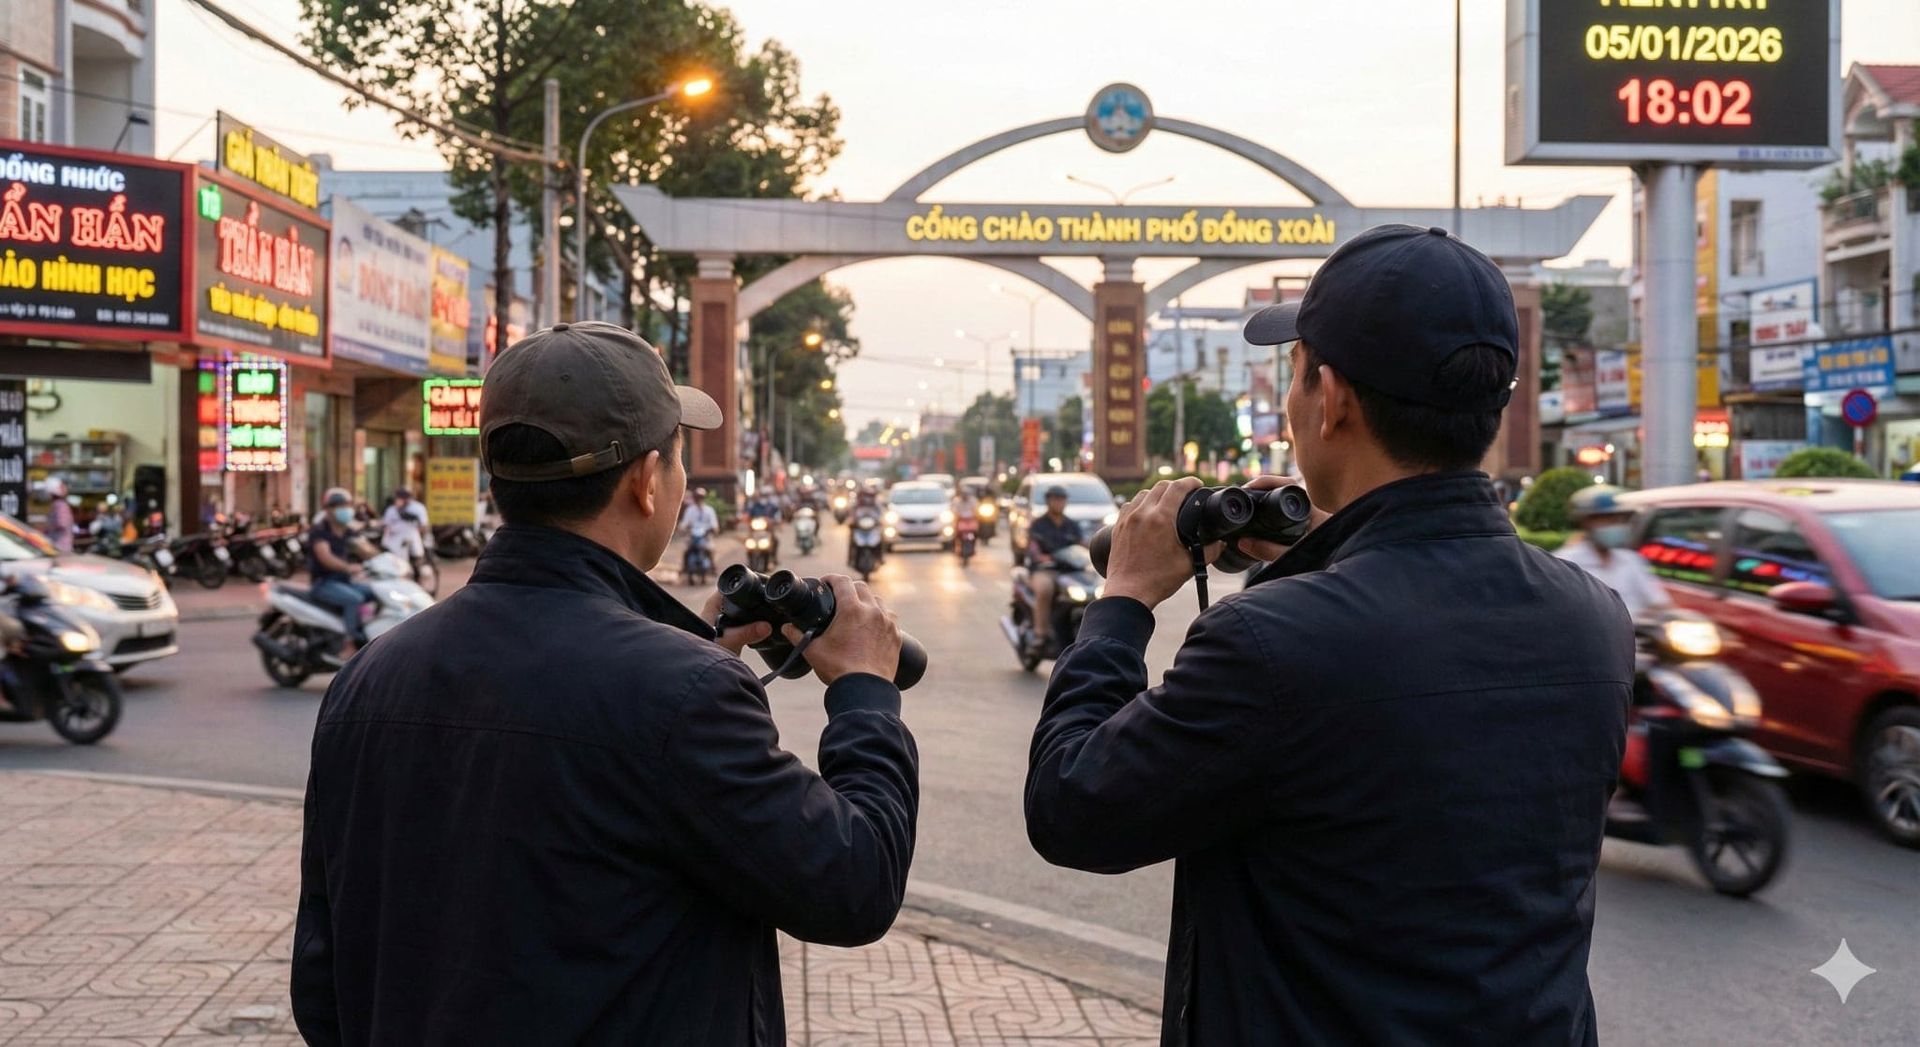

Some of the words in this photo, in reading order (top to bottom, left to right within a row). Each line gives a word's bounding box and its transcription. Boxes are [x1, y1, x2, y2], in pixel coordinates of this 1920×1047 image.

[1585, 25, 1783, 62] 05/01/2026
[1618, 78, 1752, 125] 18:02
[906, 203, 978, 241] CỔNG
[982, 210, 1054, 241] CHÀO
[1056, 211, 1140, 242] THÀNH
[1145, 209, 1198, 243] PHỐ
[1277, 213, 1335, 244] XOÀI
[106, 266, 155, 302] HỌC
